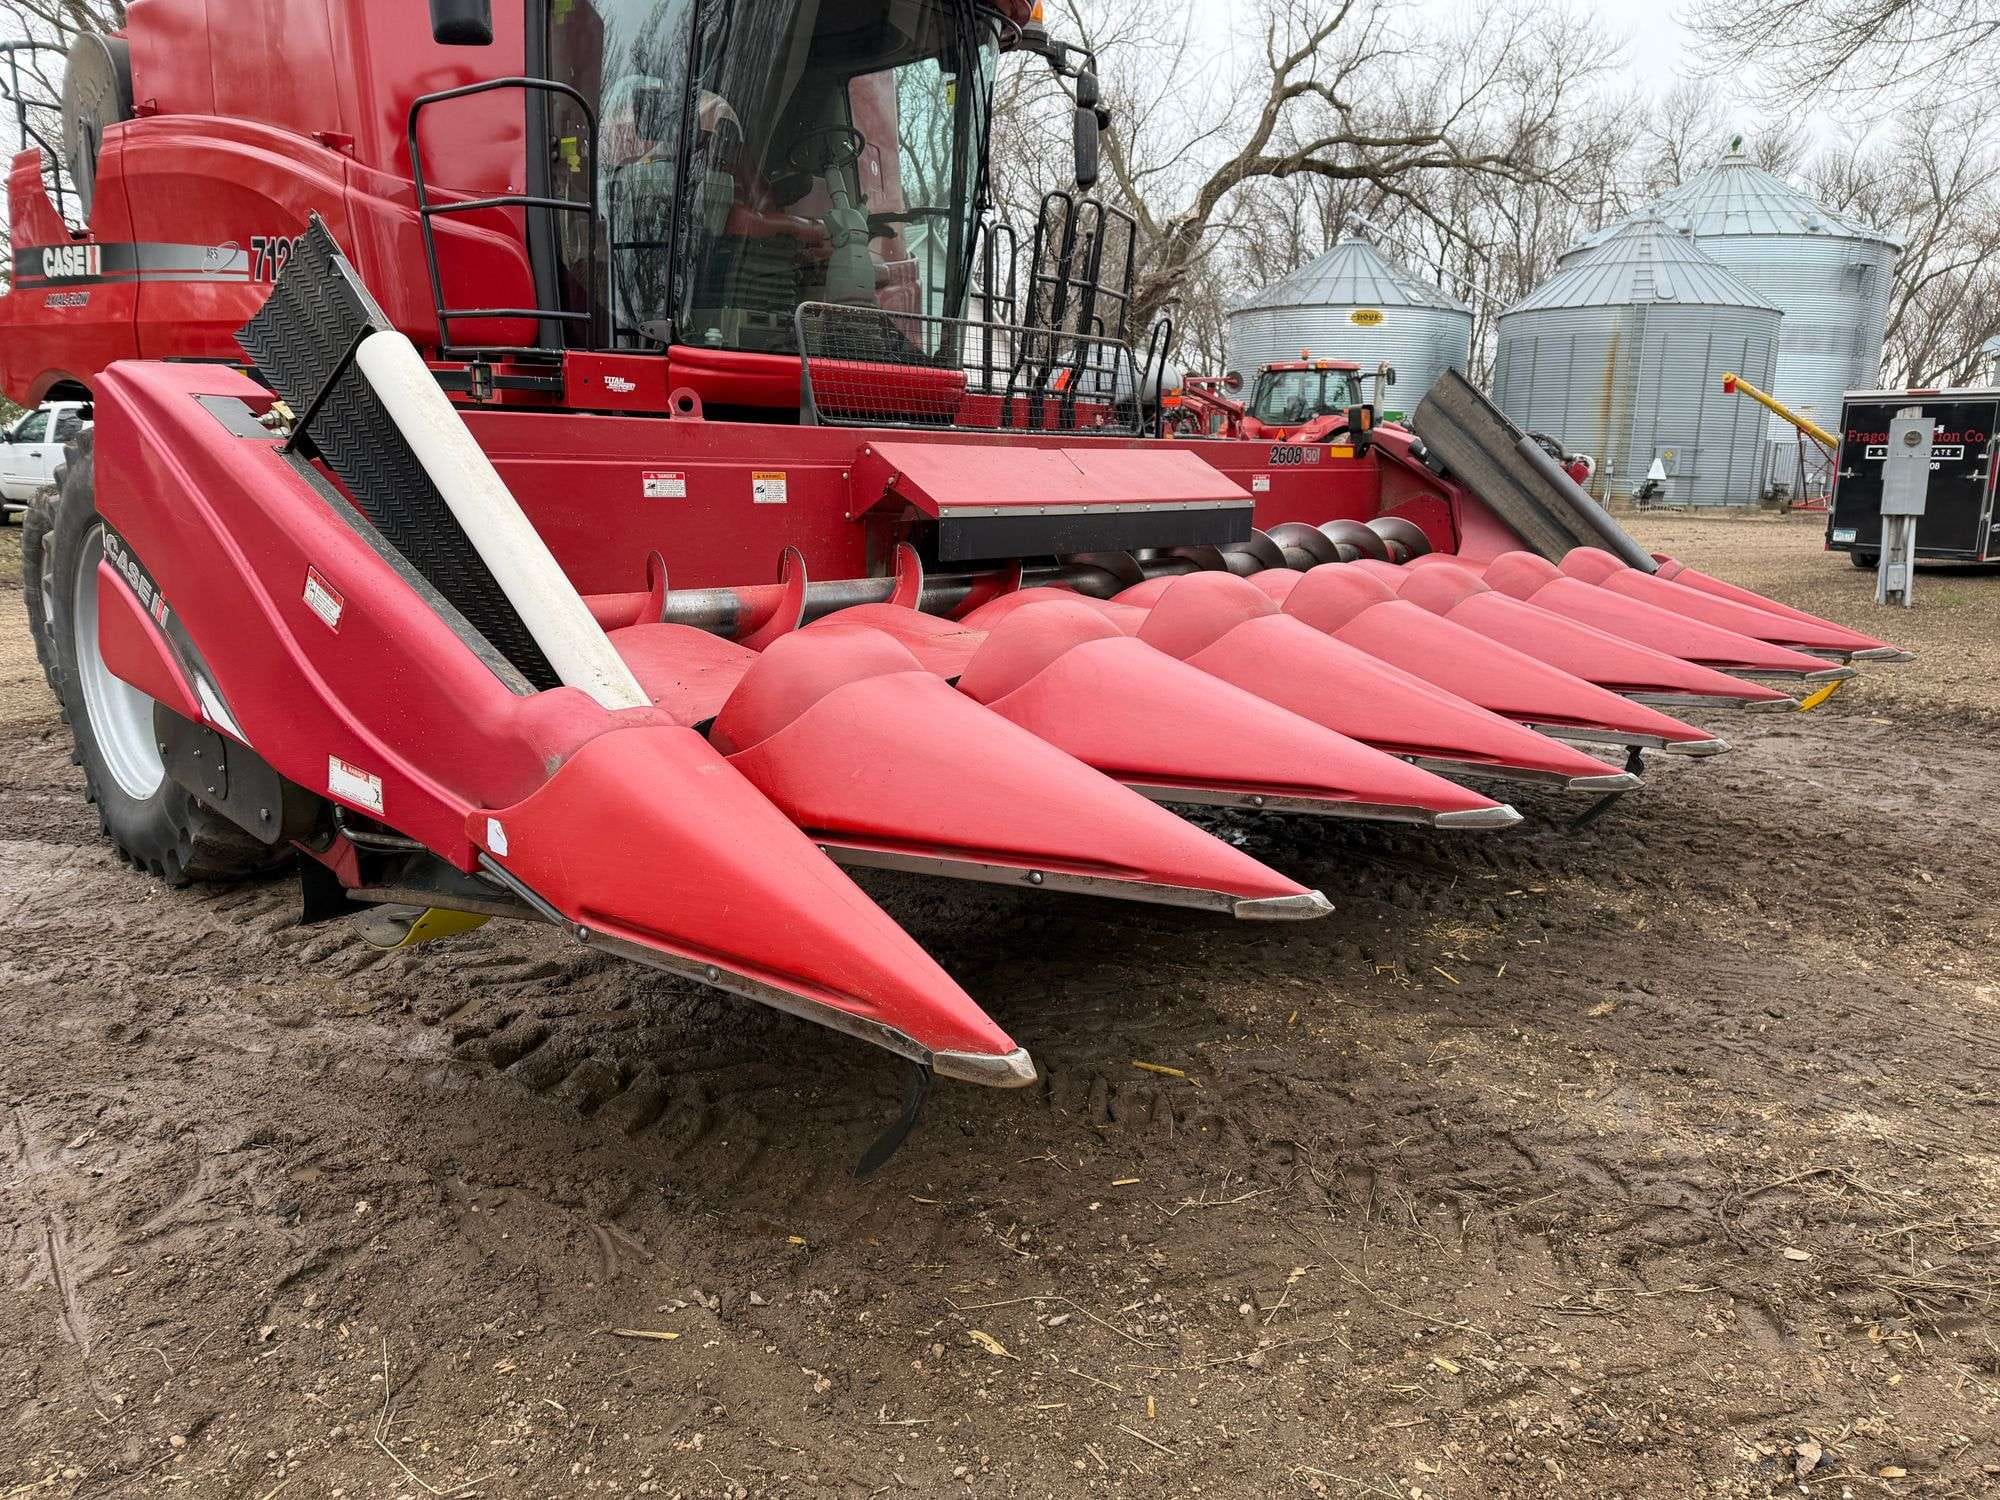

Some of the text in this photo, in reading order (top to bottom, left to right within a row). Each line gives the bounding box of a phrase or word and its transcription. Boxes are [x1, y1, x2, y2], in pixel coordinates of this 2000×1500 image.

[43, 246, 85, 278] CASE
[1848, 430, 1986, 444] Frago tion Co.
[1269, 446, 1303, 465] 2608
[1933, 448, 1951, 456] ATE
[105, 533, 153, 608] CASE
